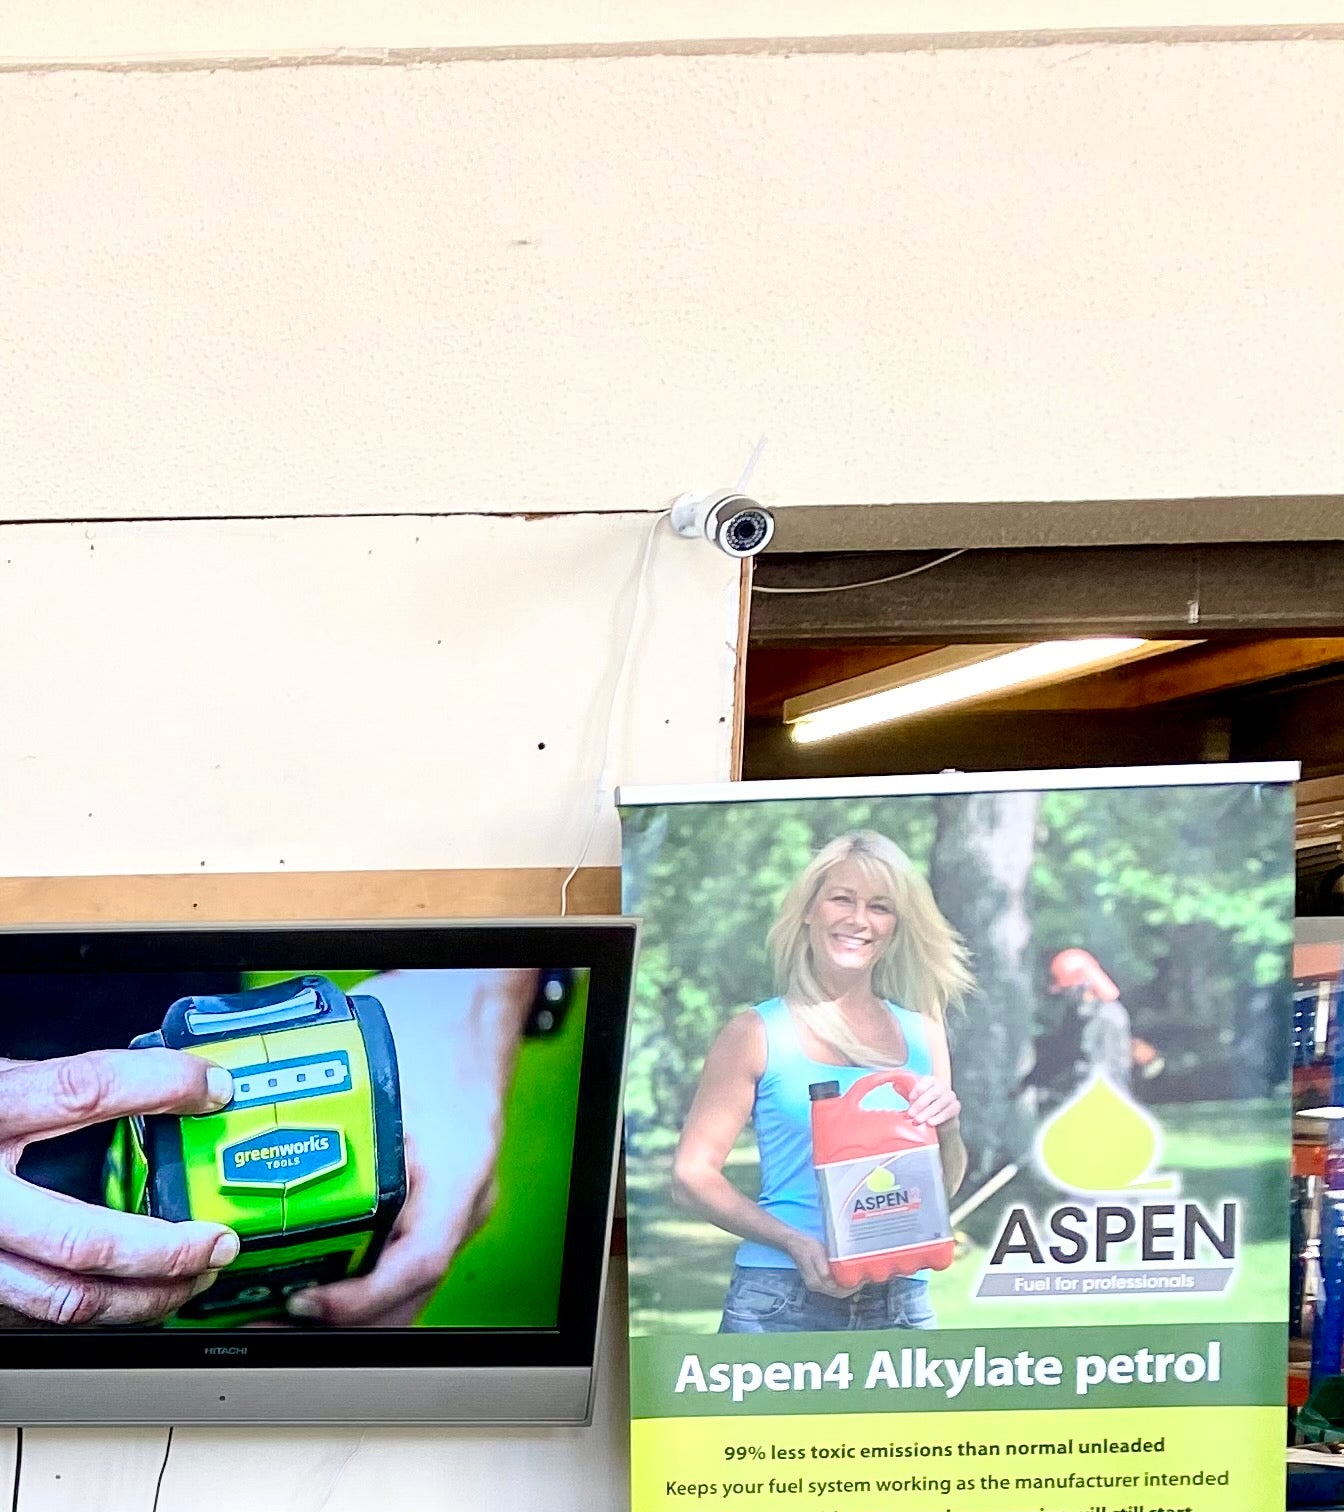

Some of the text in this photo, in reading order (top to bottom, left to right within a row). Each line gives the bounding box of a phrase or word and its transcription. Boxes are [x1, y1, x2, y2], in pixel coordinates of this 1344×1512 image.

[234, 1135, 330, 1168] greenworks
[265, 1157, 301, 1170] TOOLS
[854, 1190, 909, 1213] ASPEN
[989, 1203, 1236, 1265] ASPEN
[1013, 1273, 1199, 1293] Fuel for professionals
[204, 1347, 248, 1355] HITACHI
[674, 1341, 1220, 1402] Aspen4 Alkylate petrol
[724, 1437, 1165, 1461] 99% less toxic emissions than normal unleaded
[666, 1470, 1229, 1499] Keeps your fuel system working as the manufacturer intended
